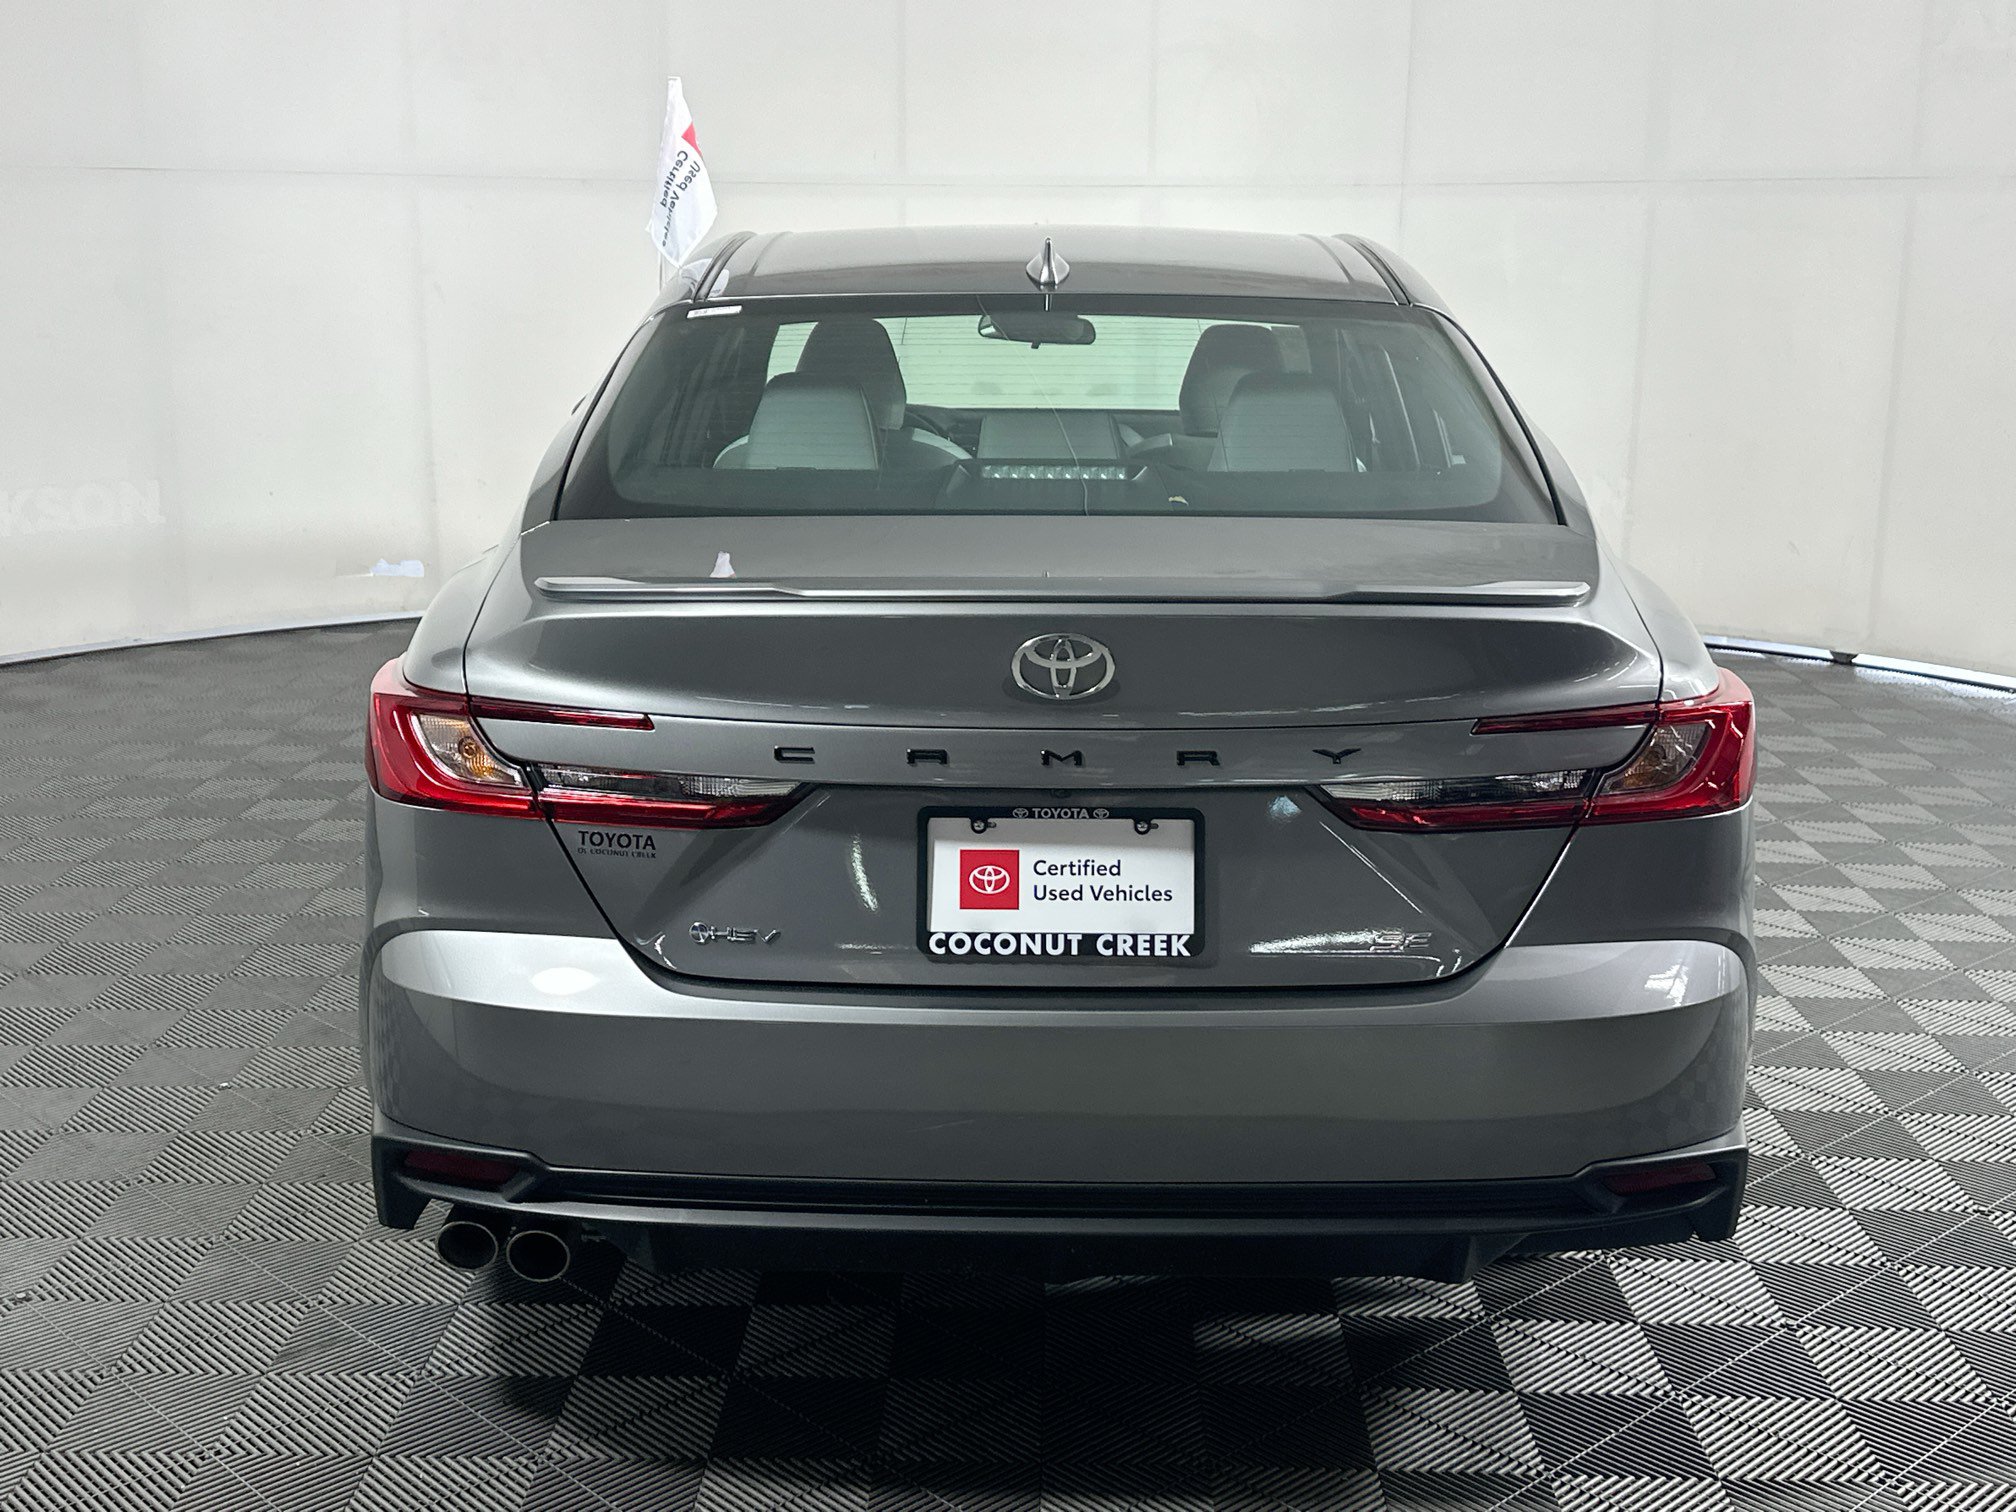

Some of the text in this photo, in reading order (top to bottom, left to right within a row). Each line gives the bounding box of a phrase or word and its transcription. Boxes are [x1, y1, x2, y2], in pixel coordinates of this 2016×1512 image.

[774, 745, 1361, 767] CAMRY
[1032, 808, 1090, 820] TOYOTA
[578, 831, 656, 850] TOYOTA
[1033, 859, 1121, 877] Certified
[1033, 884, 1173, 902] Used Vehicles
[928, 932, 1192, 957] COCONUT CREEK
